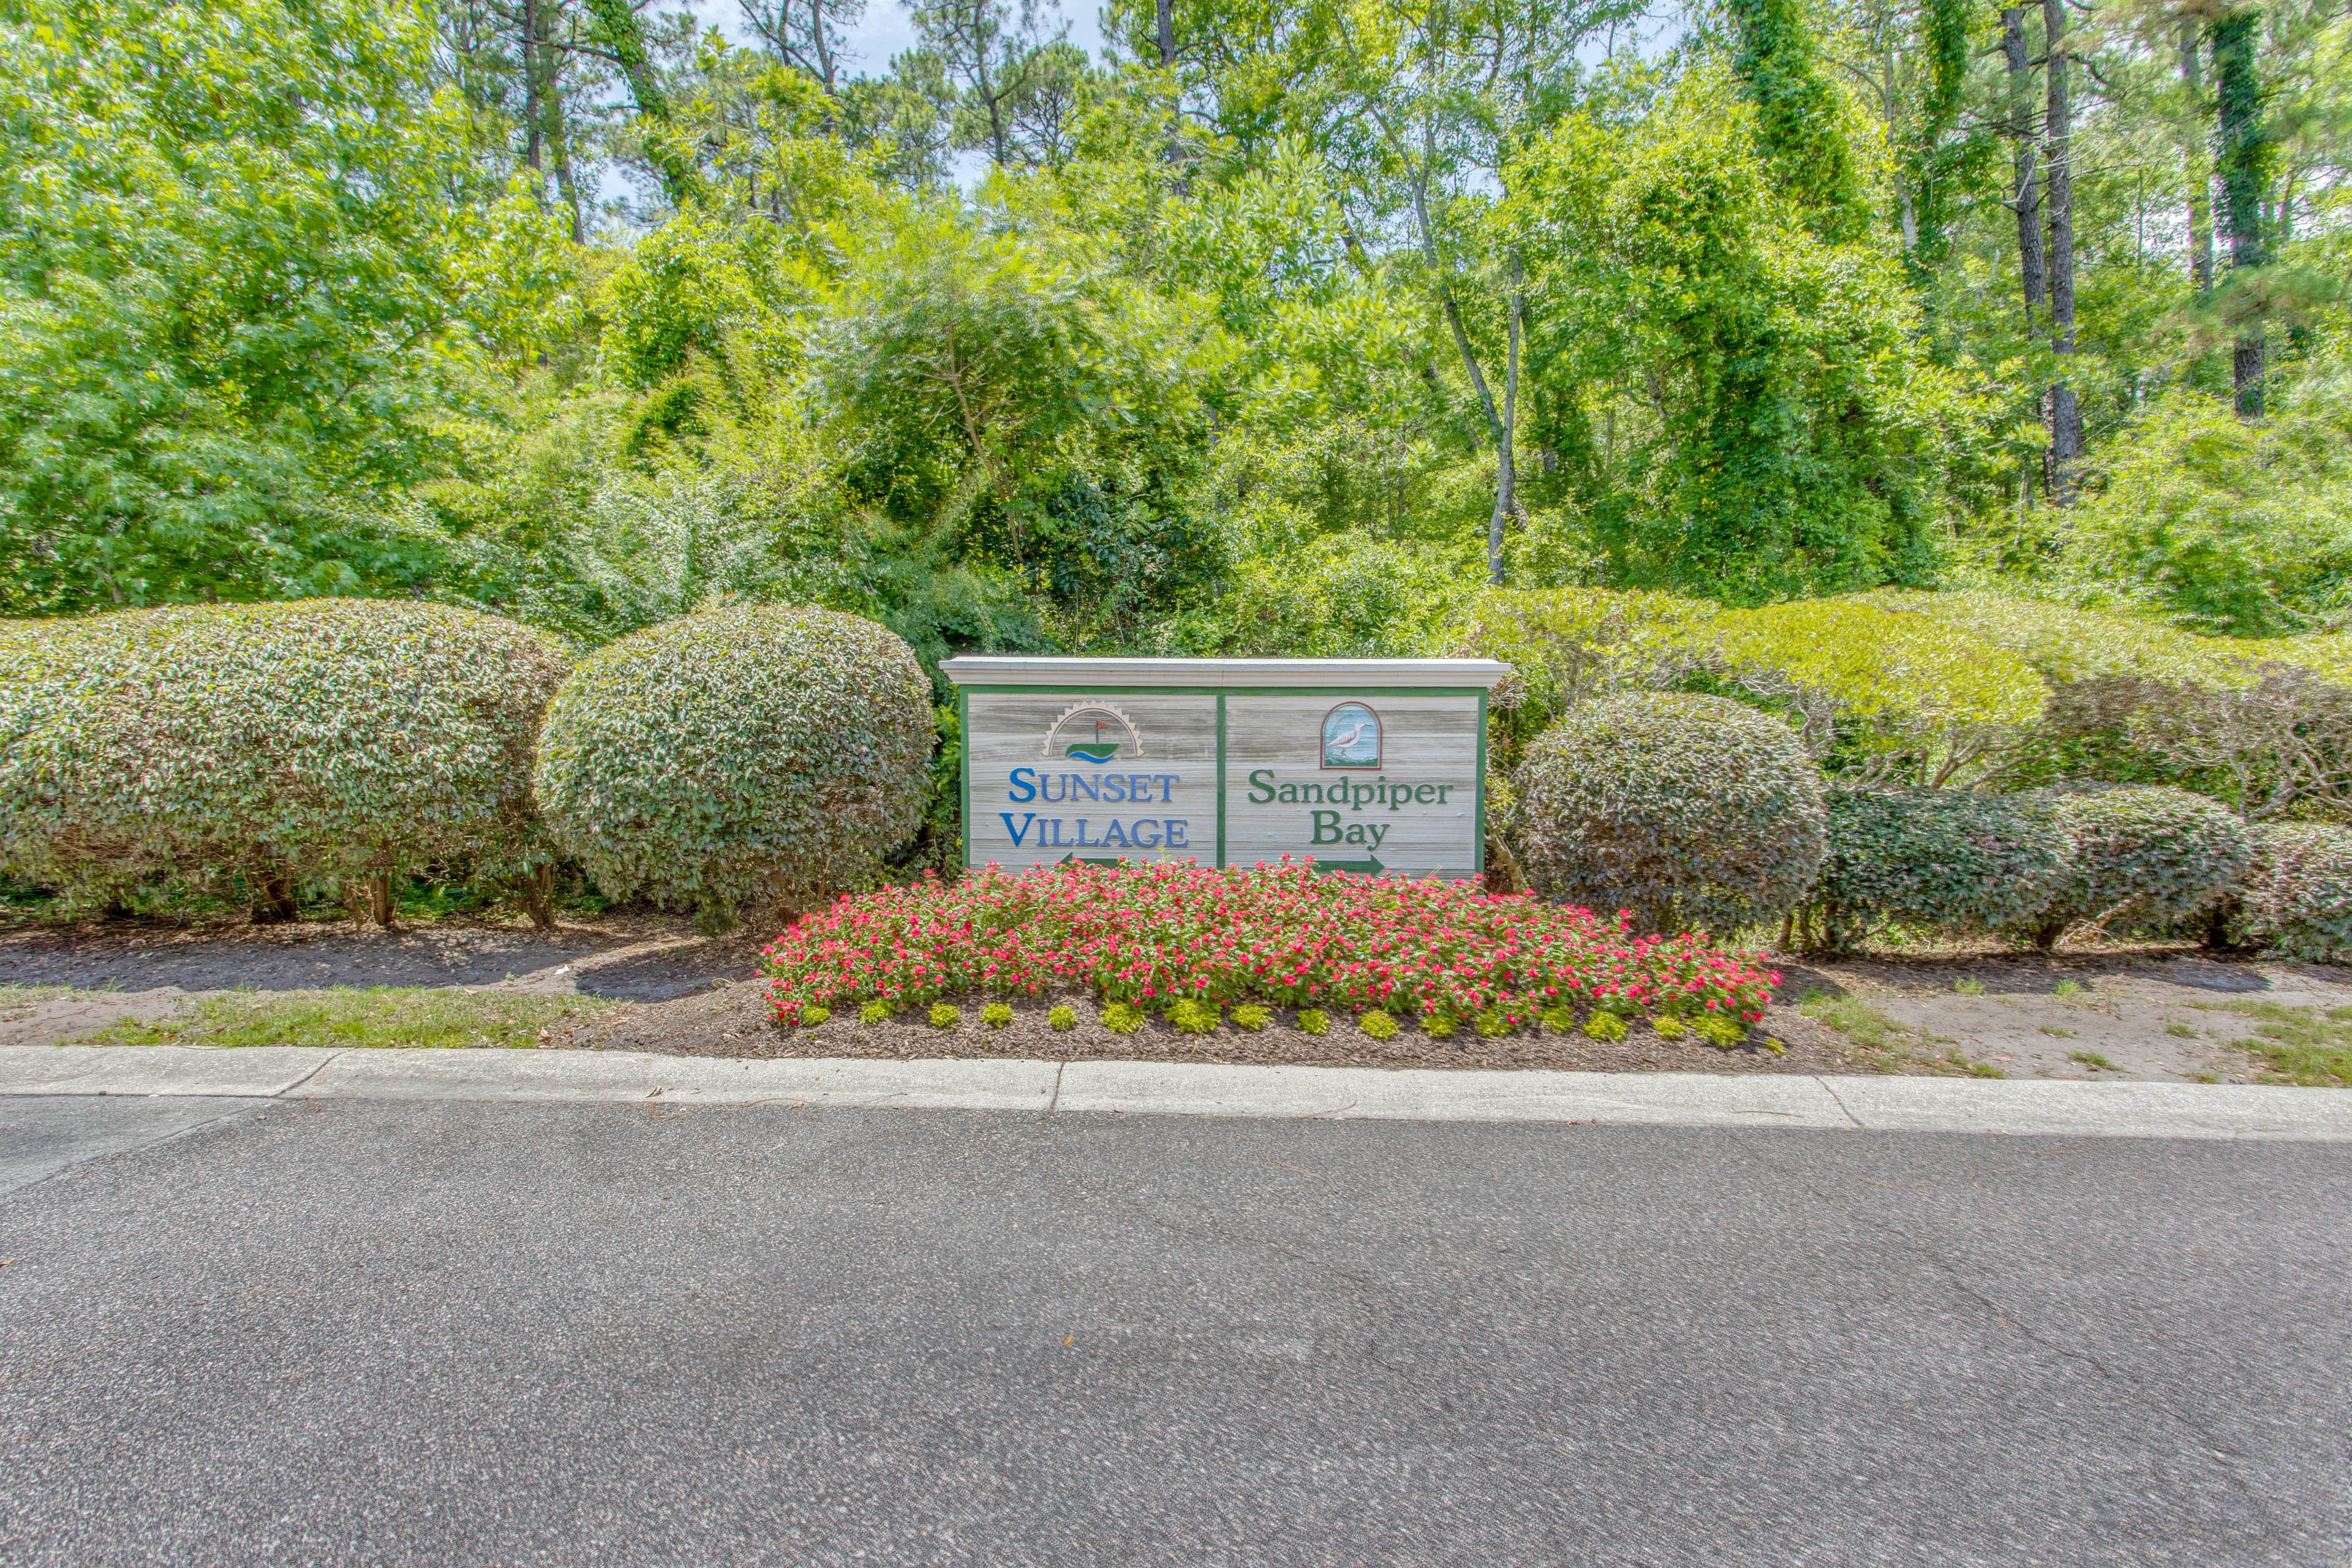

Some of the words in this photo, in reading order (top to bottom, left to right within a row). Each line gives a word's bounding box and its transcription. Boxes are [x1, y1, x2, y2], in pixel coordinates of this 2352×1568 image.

[1009, 767, 1180, 802] SUNSET
[1248, 769, 1454, 810] Sandpiper
[999, 812, 1189, 848] VILLAGE
[1310, 810, 1390, 851] Bay
